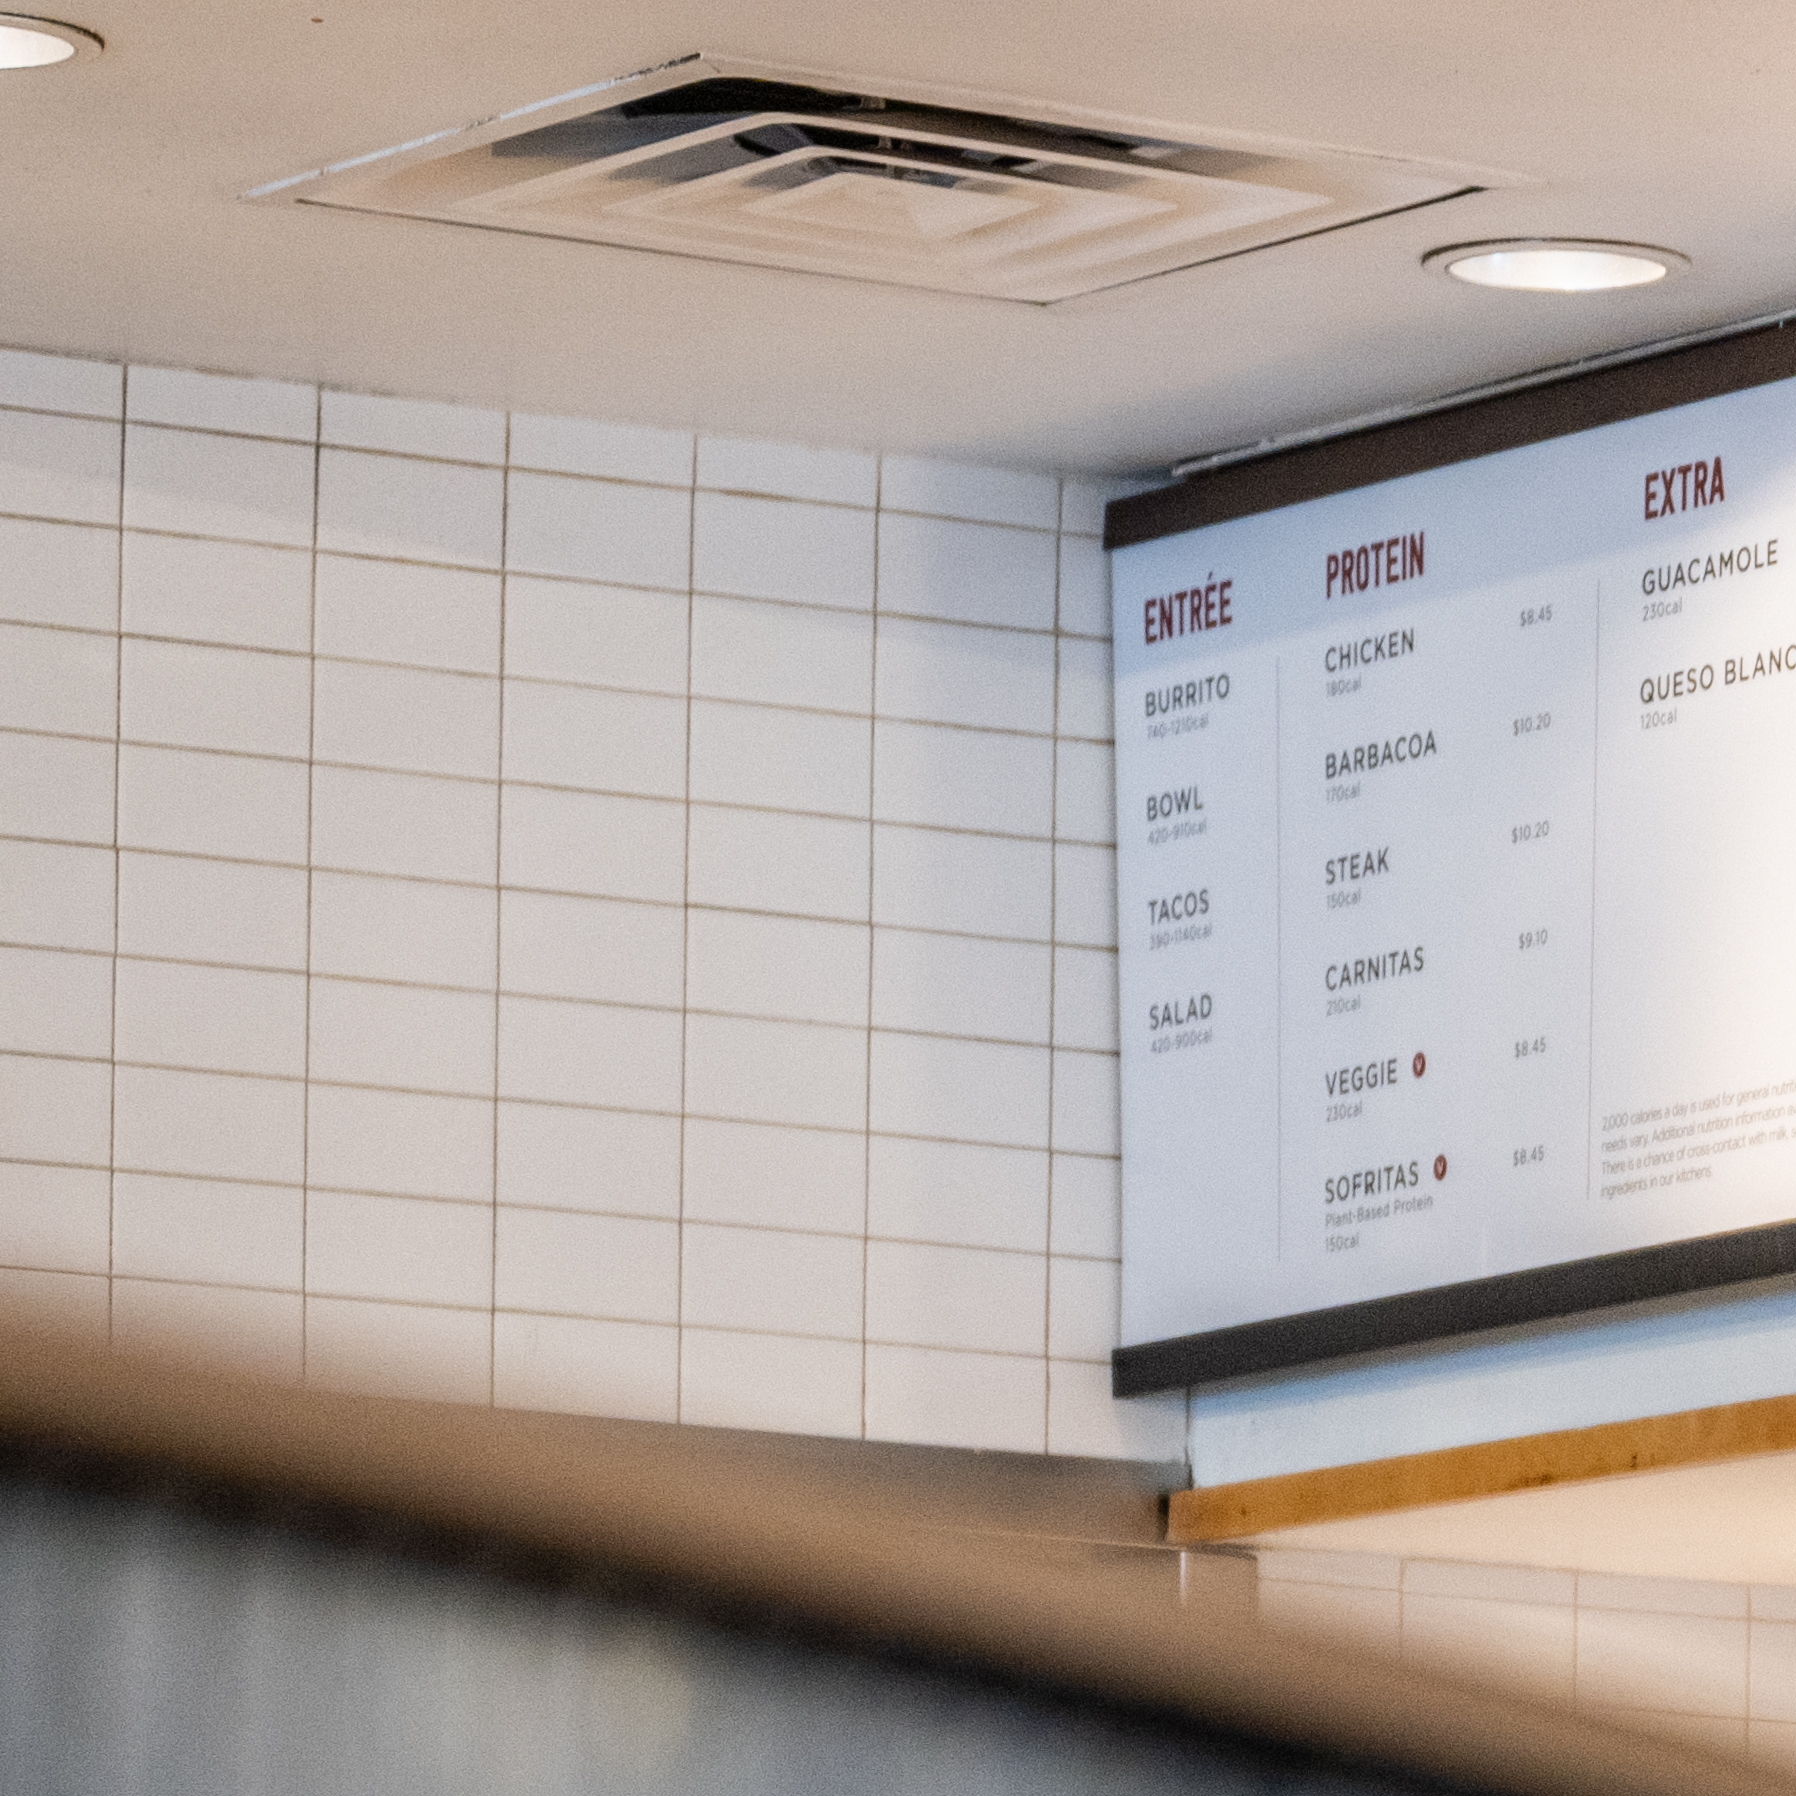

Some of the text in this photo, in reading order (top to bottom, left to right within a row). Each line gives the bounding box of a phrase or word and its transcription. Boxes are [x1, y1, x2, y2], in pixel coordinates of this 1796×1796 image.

[1645, 457, 1724, 520] EXTRA
[1326, 532, 1424, 599] PROTEIN
[1642, 539, 1778, 596] GUACAMOLE
[1145, 572, 1232, 645] ENTRÉE
[1642, 598, 1682, 622] 230cal
[1325, 629, 1414, 673] CHICKEN
[1145, 673, 1230, 718] BURRITO
[1640, 664, 1714, 704] QUESO
[1513, 712, 1551, 737] $10.20
[1640, 708, 1677, 730] 120cal
[1325, 730, 1437, 780] BARBACOA
[1147, 787, 1203, 822] BOWL
[1511, 820, 1550, 844] $10.20
[1326, 848, 1389, 885] STEAK
[1148, 888, 1209, 924] TACOS
[1325, 946, 1424, 991] CARNITAS
[1149, 993, 1212, 1030] SALAD
[1325, 1058, 1397, 1096] VEGGIE
[1325, 1160, 1419, 1205] SOFRITAS
[1393, 1195, 1434, 1214] Protein
